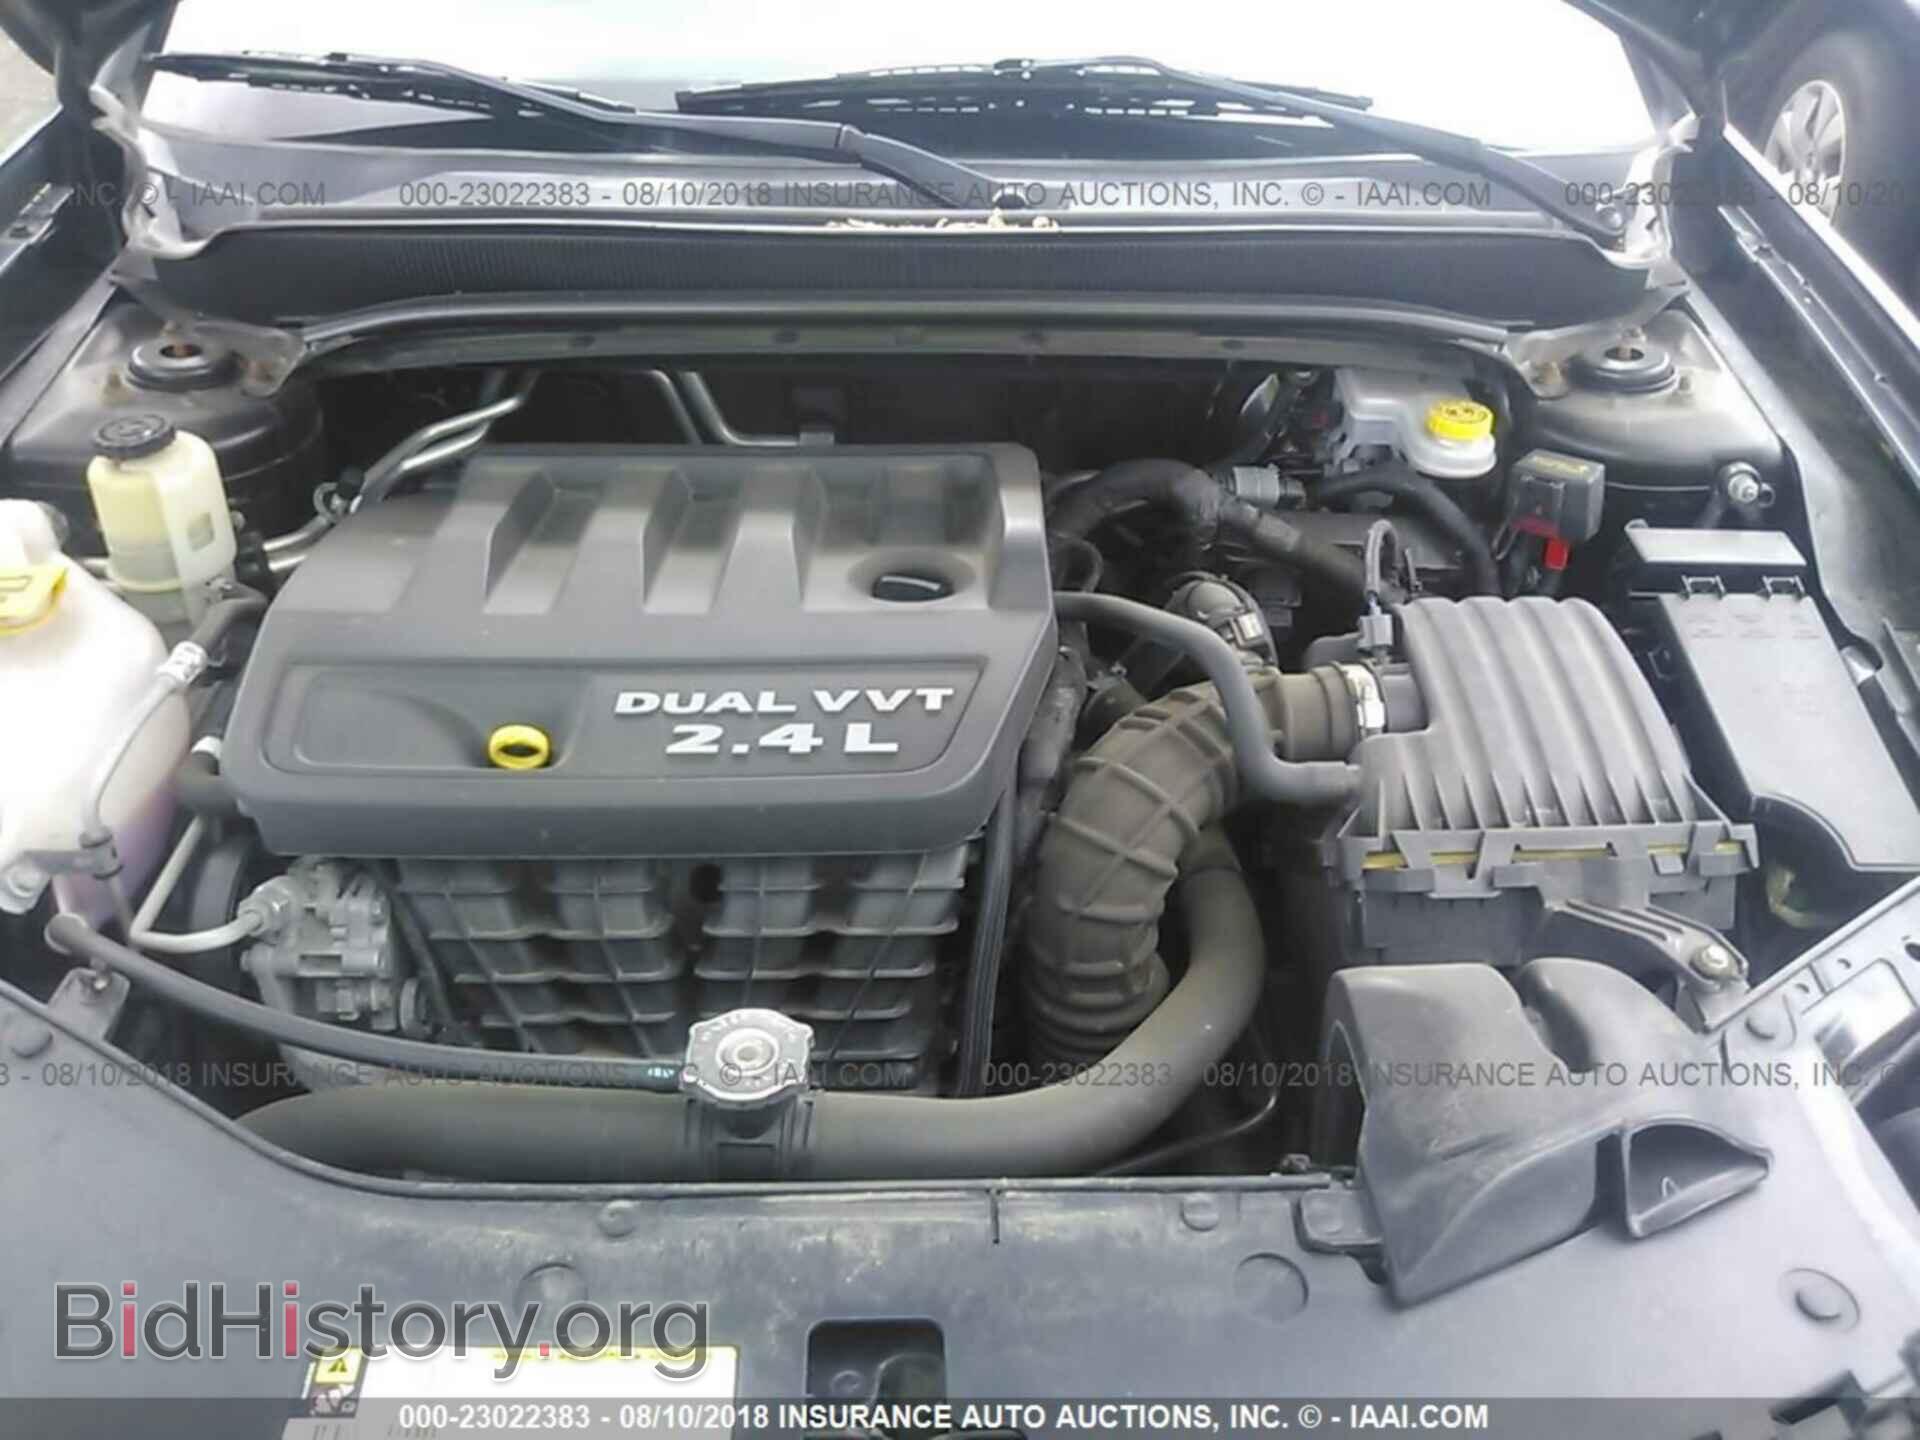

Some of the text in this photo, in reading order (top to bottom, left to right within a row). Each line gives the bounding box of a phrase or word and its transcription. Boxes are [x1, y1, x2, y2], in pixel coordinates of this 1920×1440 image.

[614, 687, 954, 714] DUAL VVT
[665, 722, 899, 754] 2.4 L
